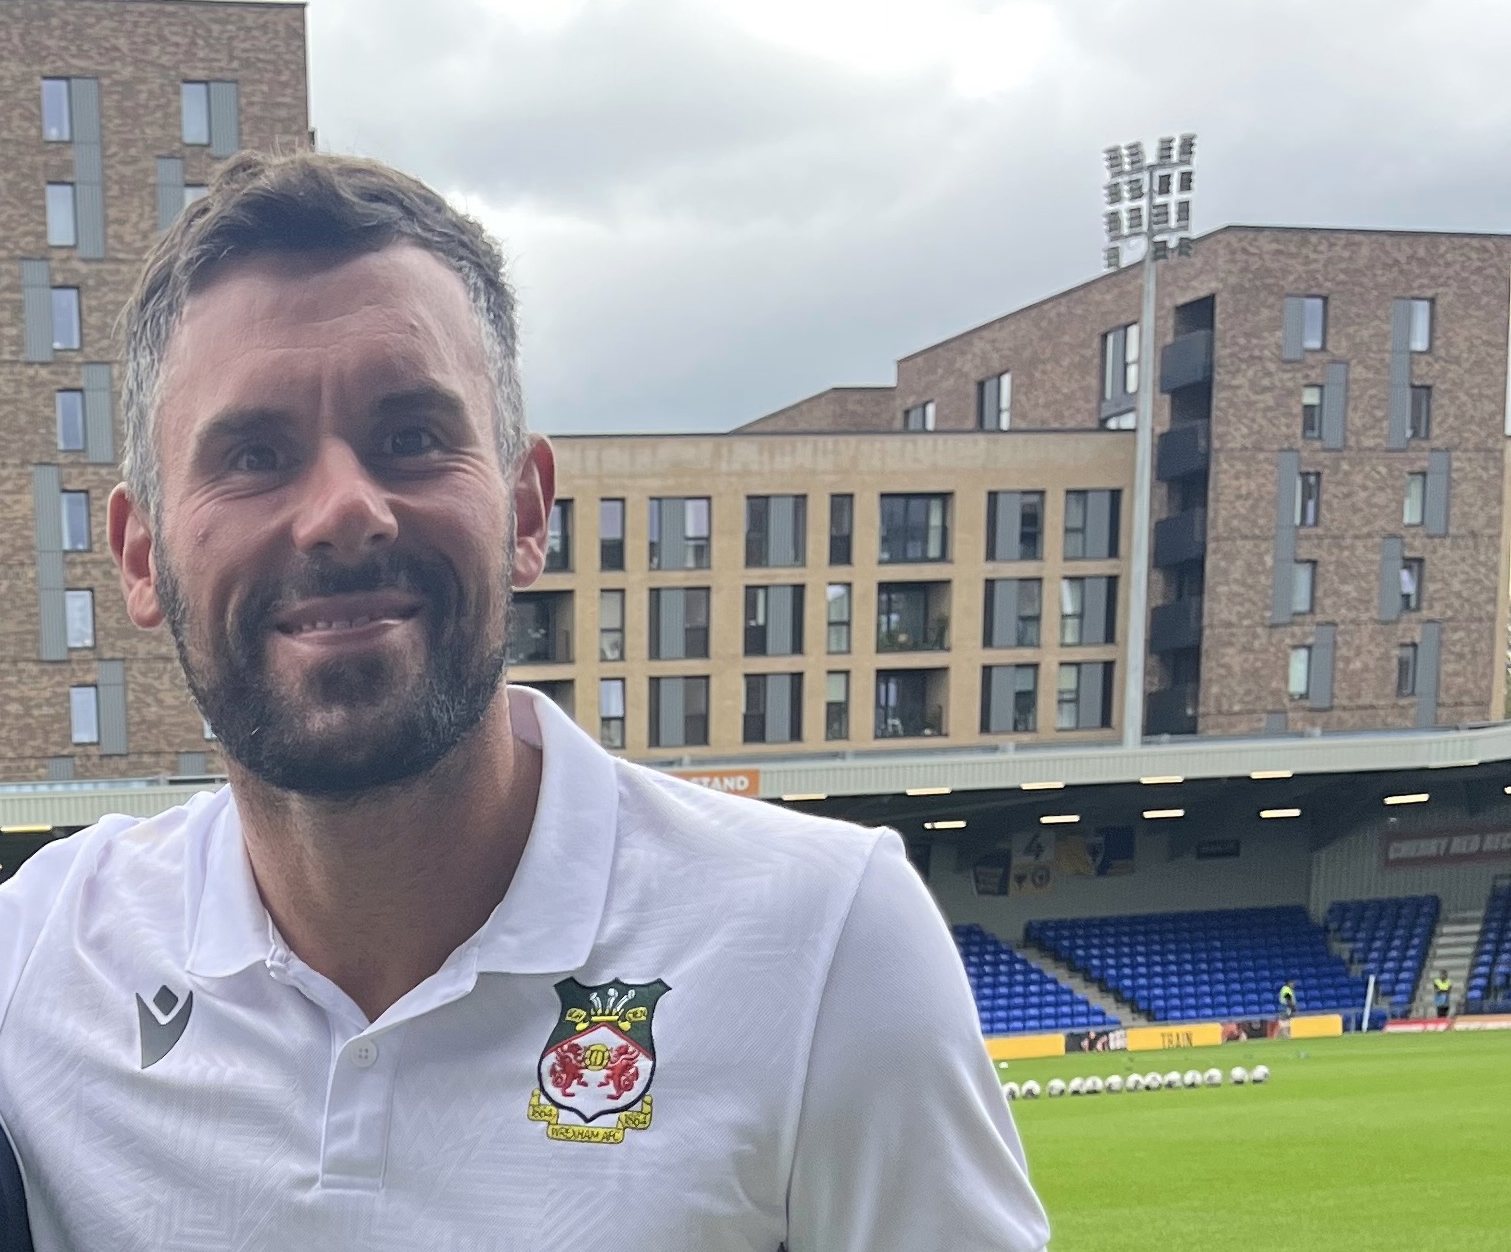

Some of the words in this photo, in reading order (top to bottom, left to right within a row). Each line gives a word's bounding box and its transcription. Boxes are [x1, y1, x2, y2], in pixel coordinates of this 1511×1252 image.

[1160, 1032, 1194, 1049] TRAIN
[551, 1127, 599, 1139] WREXHAM
[602, 1131, 621, 1141] AFC
